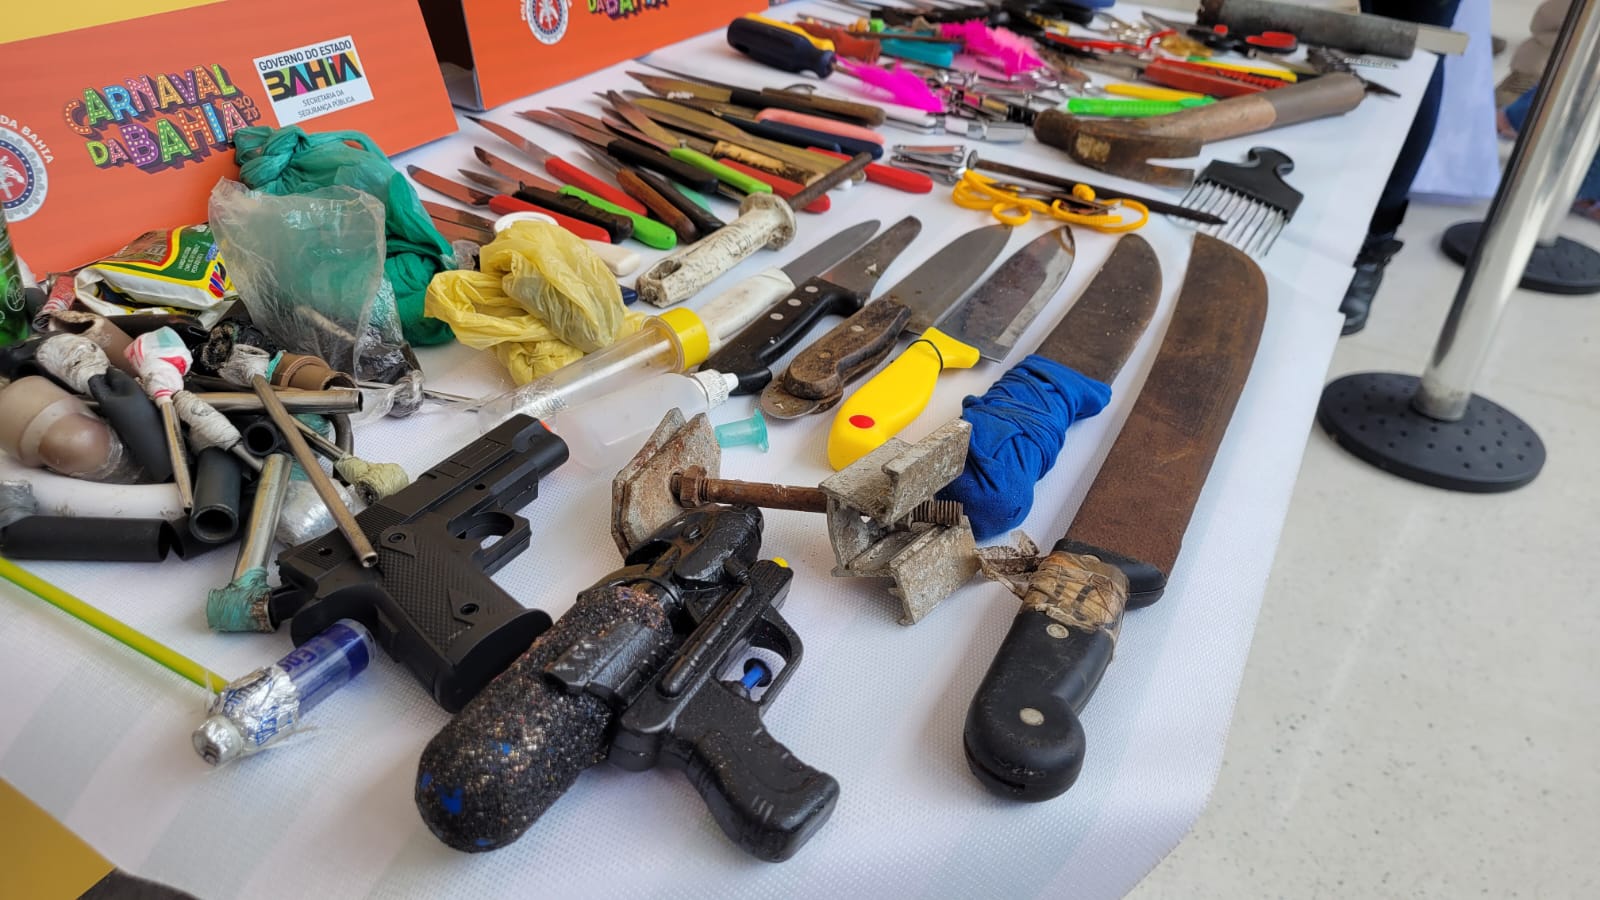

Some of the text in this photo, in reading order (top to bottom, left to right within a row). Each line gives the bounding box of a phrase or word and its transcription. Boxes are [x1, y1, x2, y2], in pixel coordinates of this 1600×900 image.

[258, 39, 352, 72] GOVERNO DO ESTADO
[262, 52, 362, 102] BAHIA
[64, 64, 237, 135] CARNAVAL
[297, 96, 355, 119] SEGURANÇA PÚBLICA
[302, 88, 345, 107] SECRETARIA DA
[21, 126, 54, 164] BAHIA
[86, 100, 249, 167] DA BAHIA
